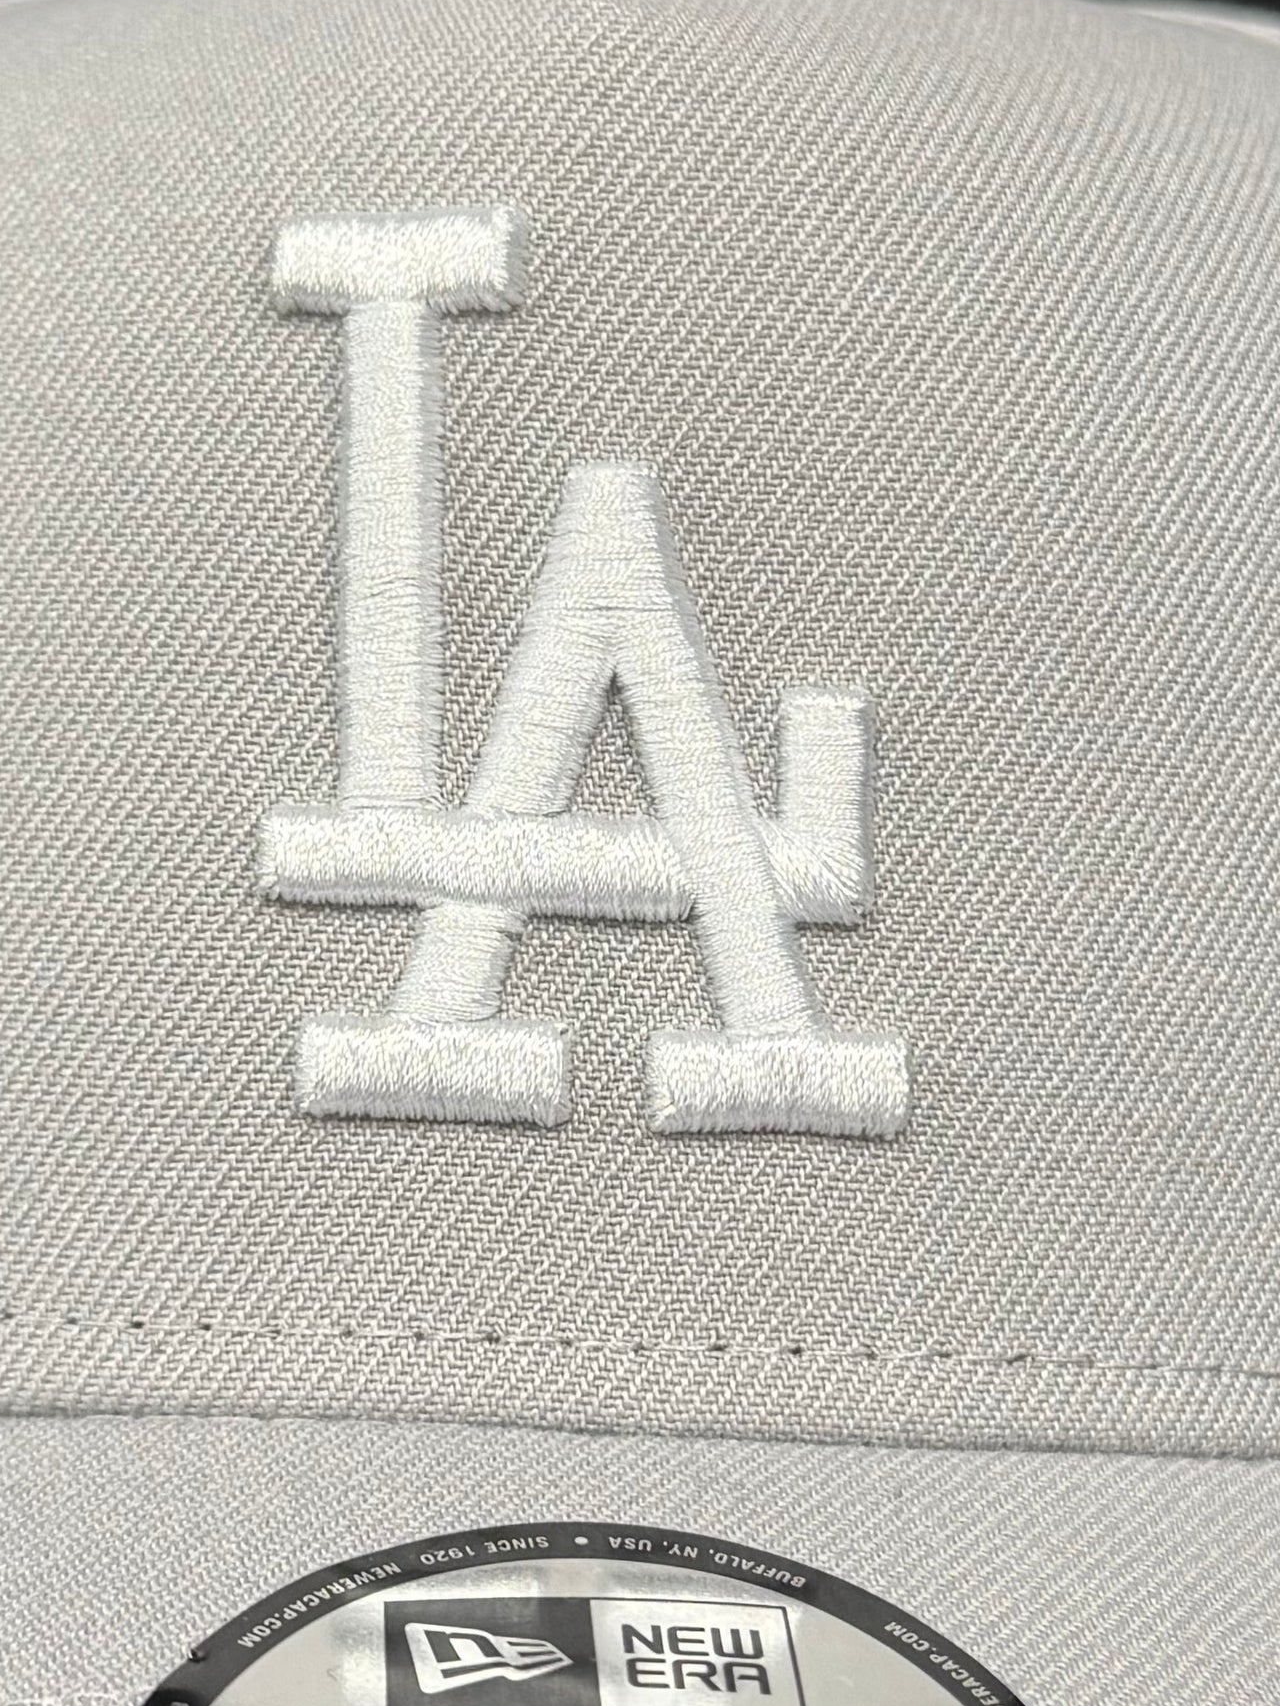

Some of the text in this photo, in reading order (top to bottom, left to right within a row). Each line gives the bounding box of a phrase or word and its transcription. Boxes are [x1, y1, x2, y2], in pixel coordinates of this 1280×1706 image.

[258, 205, 915, 1141] LA
[420, 1545, 475, 1566] 1920
[484, 1536, 549, 1554] SINCE
[608, 1536, 652, 1552] USA
[236, 1561, 403, 1649] NEWERACAP.COM
[621, 1624, 763, 1659] NEW
[626, 1657, 772, 1695] ERA
